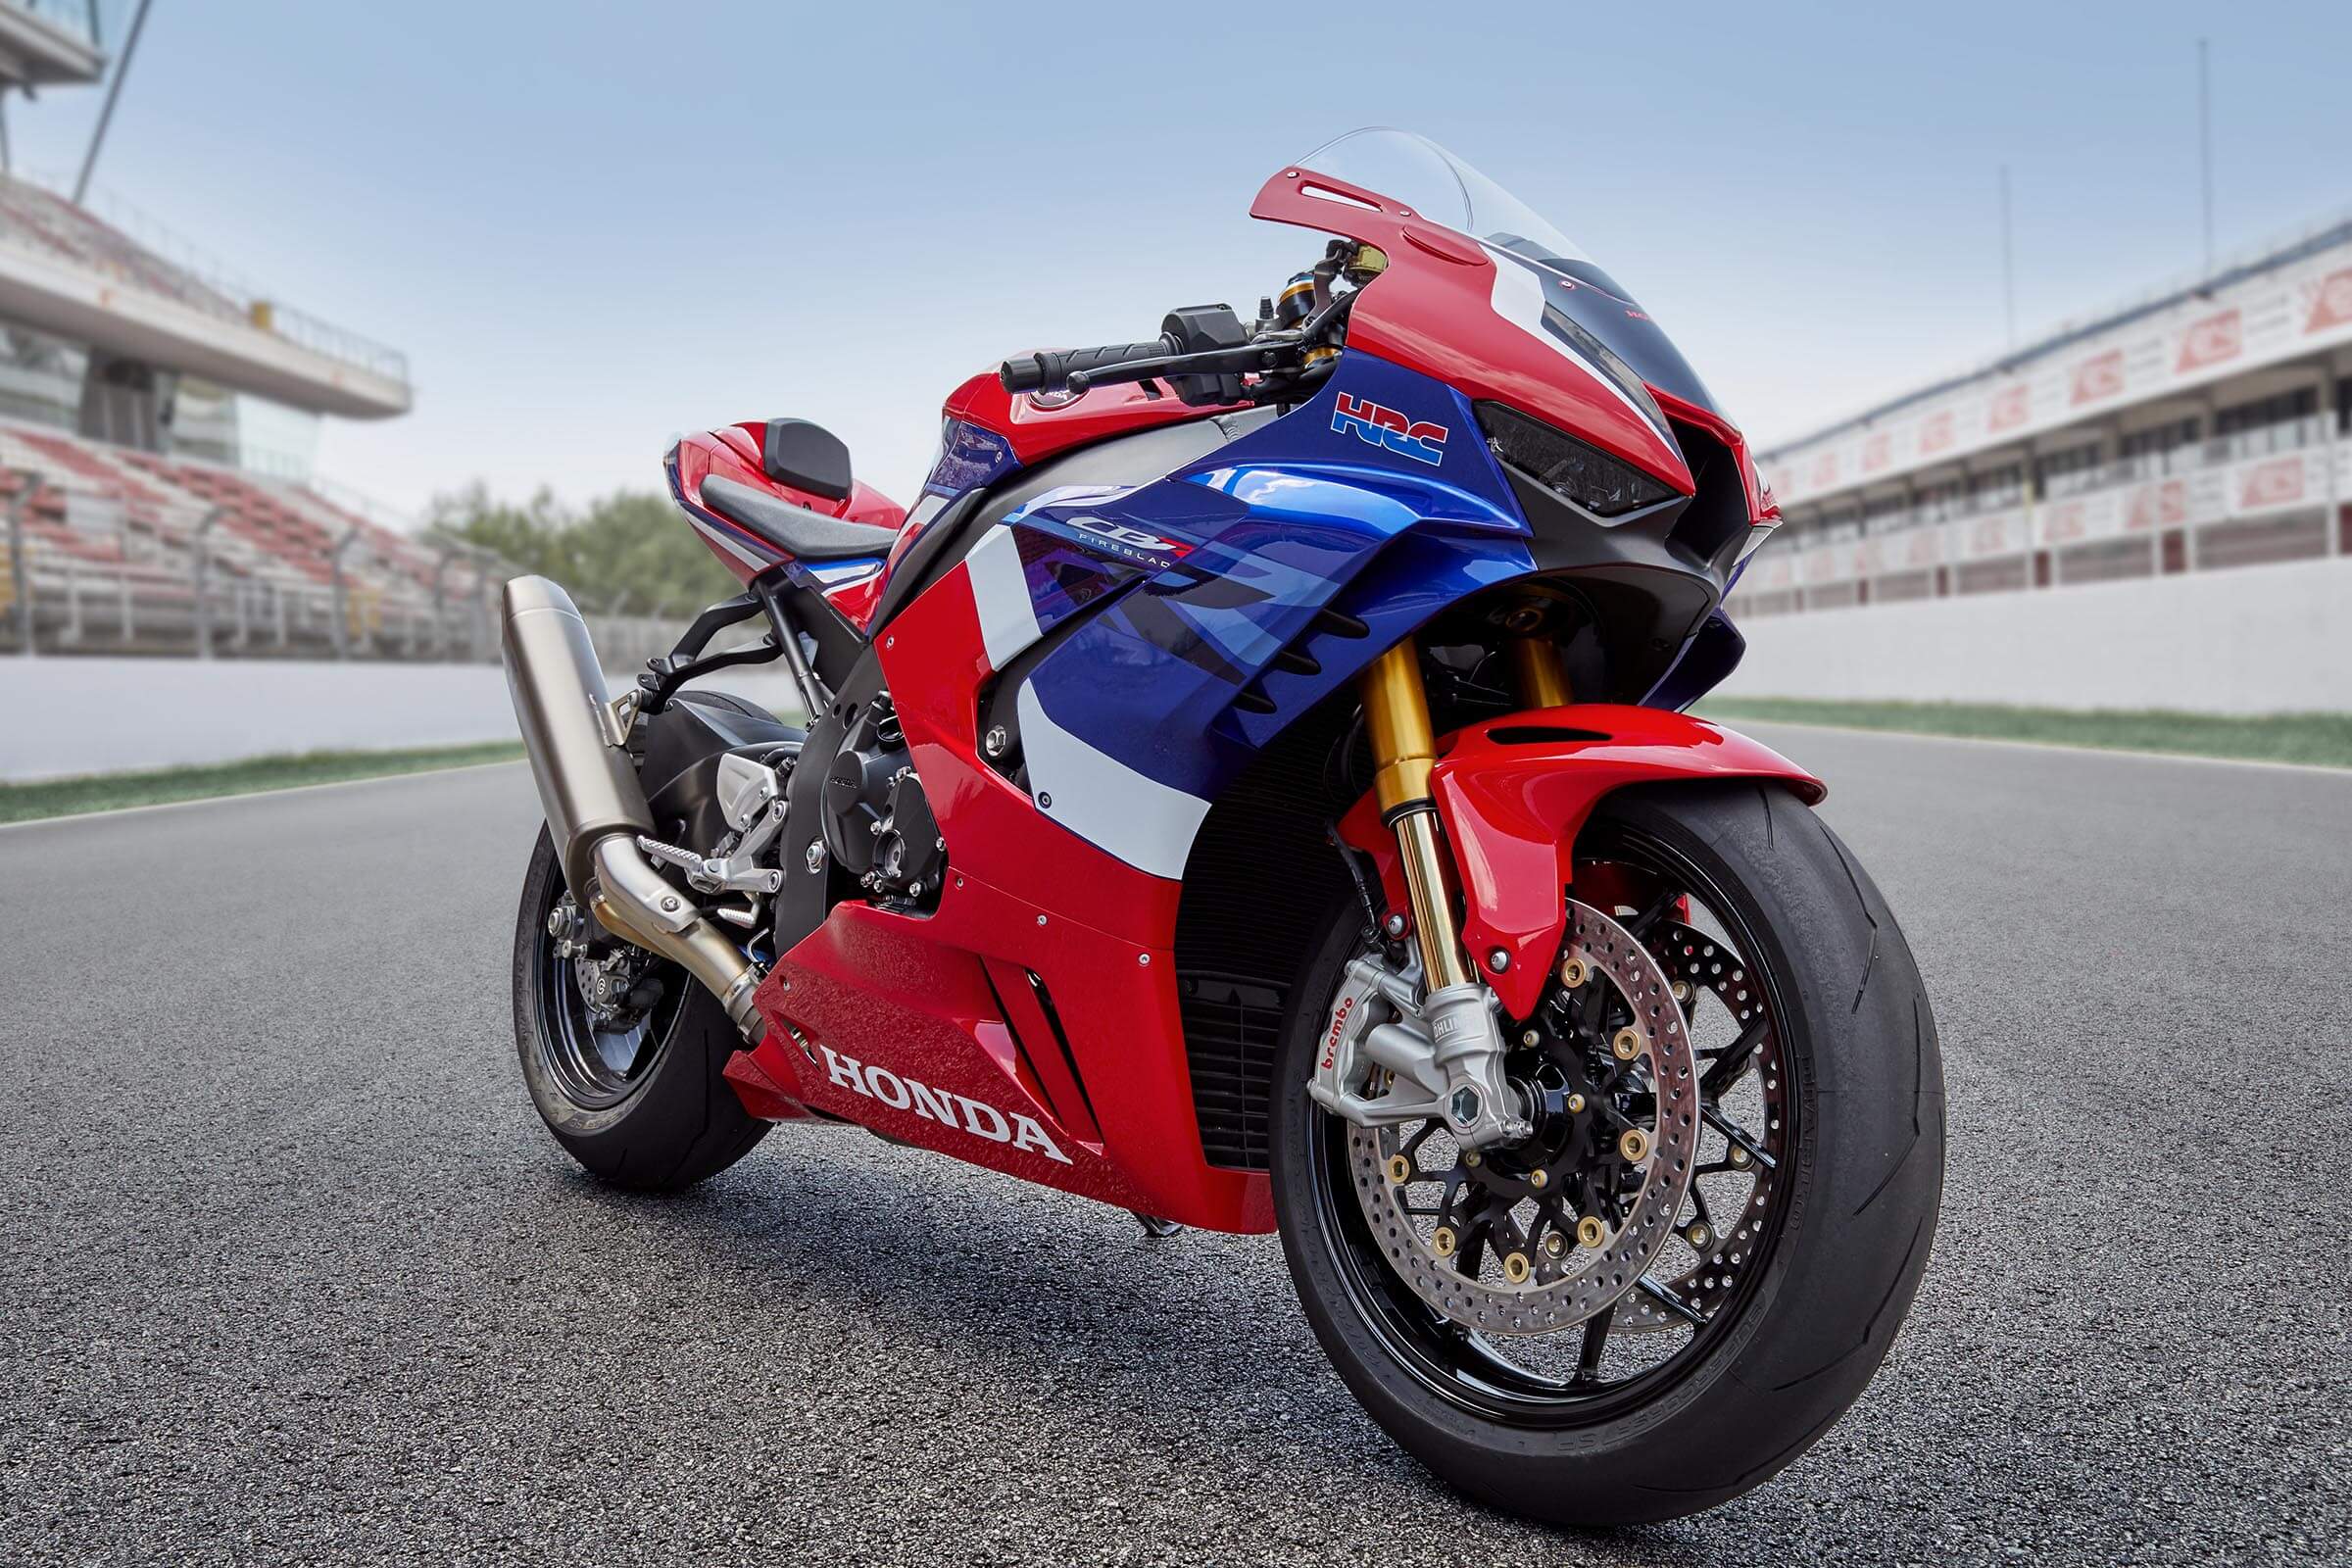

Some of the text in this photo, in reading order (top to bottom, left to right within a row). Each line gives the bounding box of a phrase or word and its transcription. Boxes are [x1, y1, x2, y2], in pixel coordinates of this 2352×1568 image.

[1331, 391, 1448, 466] HRC
[1078, 533, 1171, 569] FIREBLAD
[1321, 997, 1353, 1069] brembo
[819, 1044, 1074, 1165] HONDA
